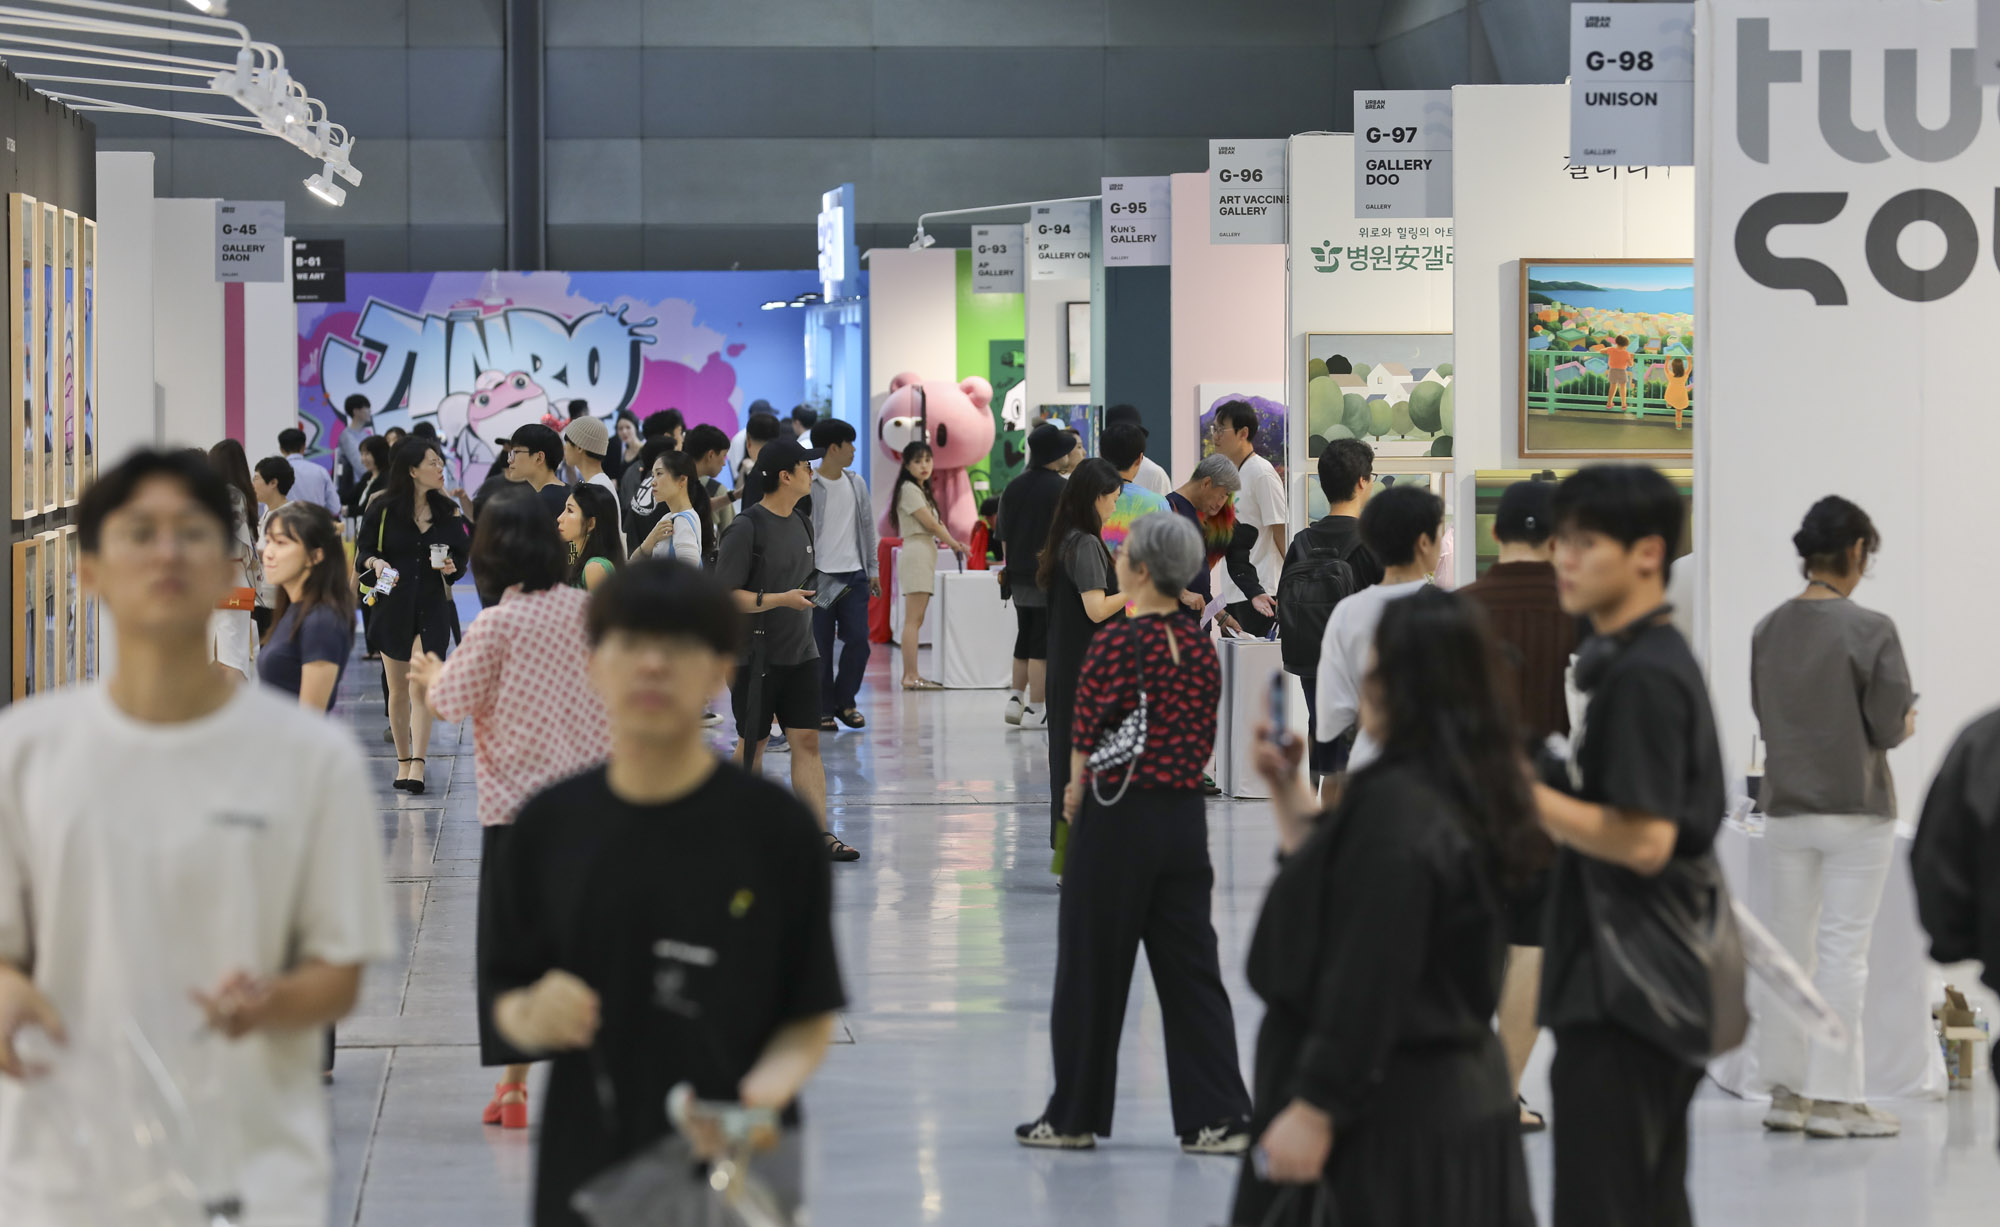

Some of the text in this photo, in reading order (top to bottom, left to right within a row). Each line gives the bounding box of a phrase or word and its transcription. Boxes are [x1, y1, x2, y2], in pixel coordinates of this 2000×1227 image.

[1586, 51, 1654, 71] G-98
[1736, 17, 2000, 164] tw
[1585, 92, 1658, 106] UNISON
[1366, 127, 1418, 143] G-97
[1366, 159, 1433, 171] GALLERY
[1219, 168, 1264, 182] G-96
[1366, 174, 1400, 185] DOO
[1219, 195, 1241, 204] ART
[1110, 202, 1147, 214] G-95
[1219, 206, 1268, 216] GALLERY
[222, 224, 257, 235] G-45
[1038, 224, 1071, 235] G-94
[1358, 227, 1392, 238] 위로와
[1396, 227, 1429, 240] 힐링의
[1110, 234, 1157, 244] GALLERY
[222, 244, 265, 253] GALLERY
[978, 244, 1007, 254] G-93
[1038, 243, 1050, 251] KP
[1734, 186, 2000, 306] so
[222, 253, 250, 262] DAON
